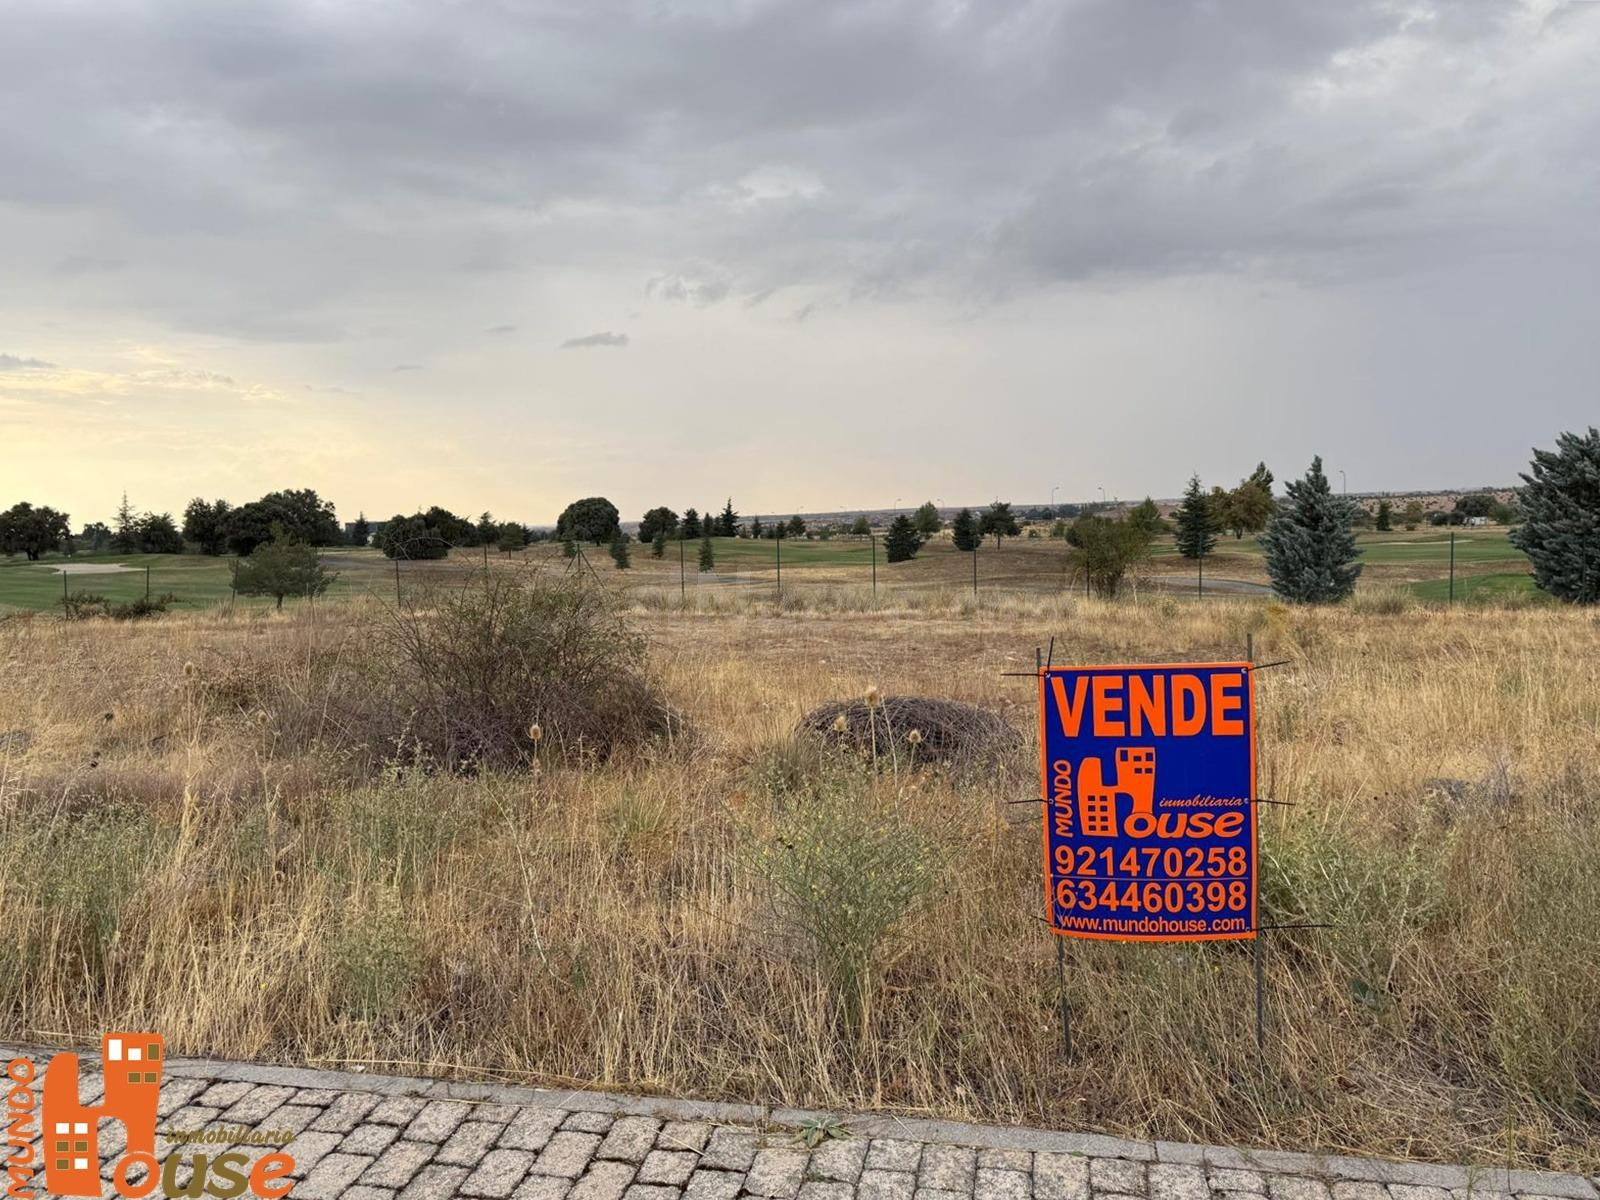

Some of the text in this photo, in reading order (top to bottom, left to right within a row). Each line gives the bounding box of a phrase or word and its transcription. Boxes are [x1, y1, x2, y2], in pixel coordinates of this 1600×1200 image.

[1050, 673, 1245, 737] VENDE
[1053, 759, 1074, 838] MUNDO
[1159, 794, 1244, 808] inmobiliaria
[1055, 846, 1248, 878] 921470258
[1057, 879, 1248, 913] 634460398
[1059, 915, 1245, 933] www.mundohouse.com
